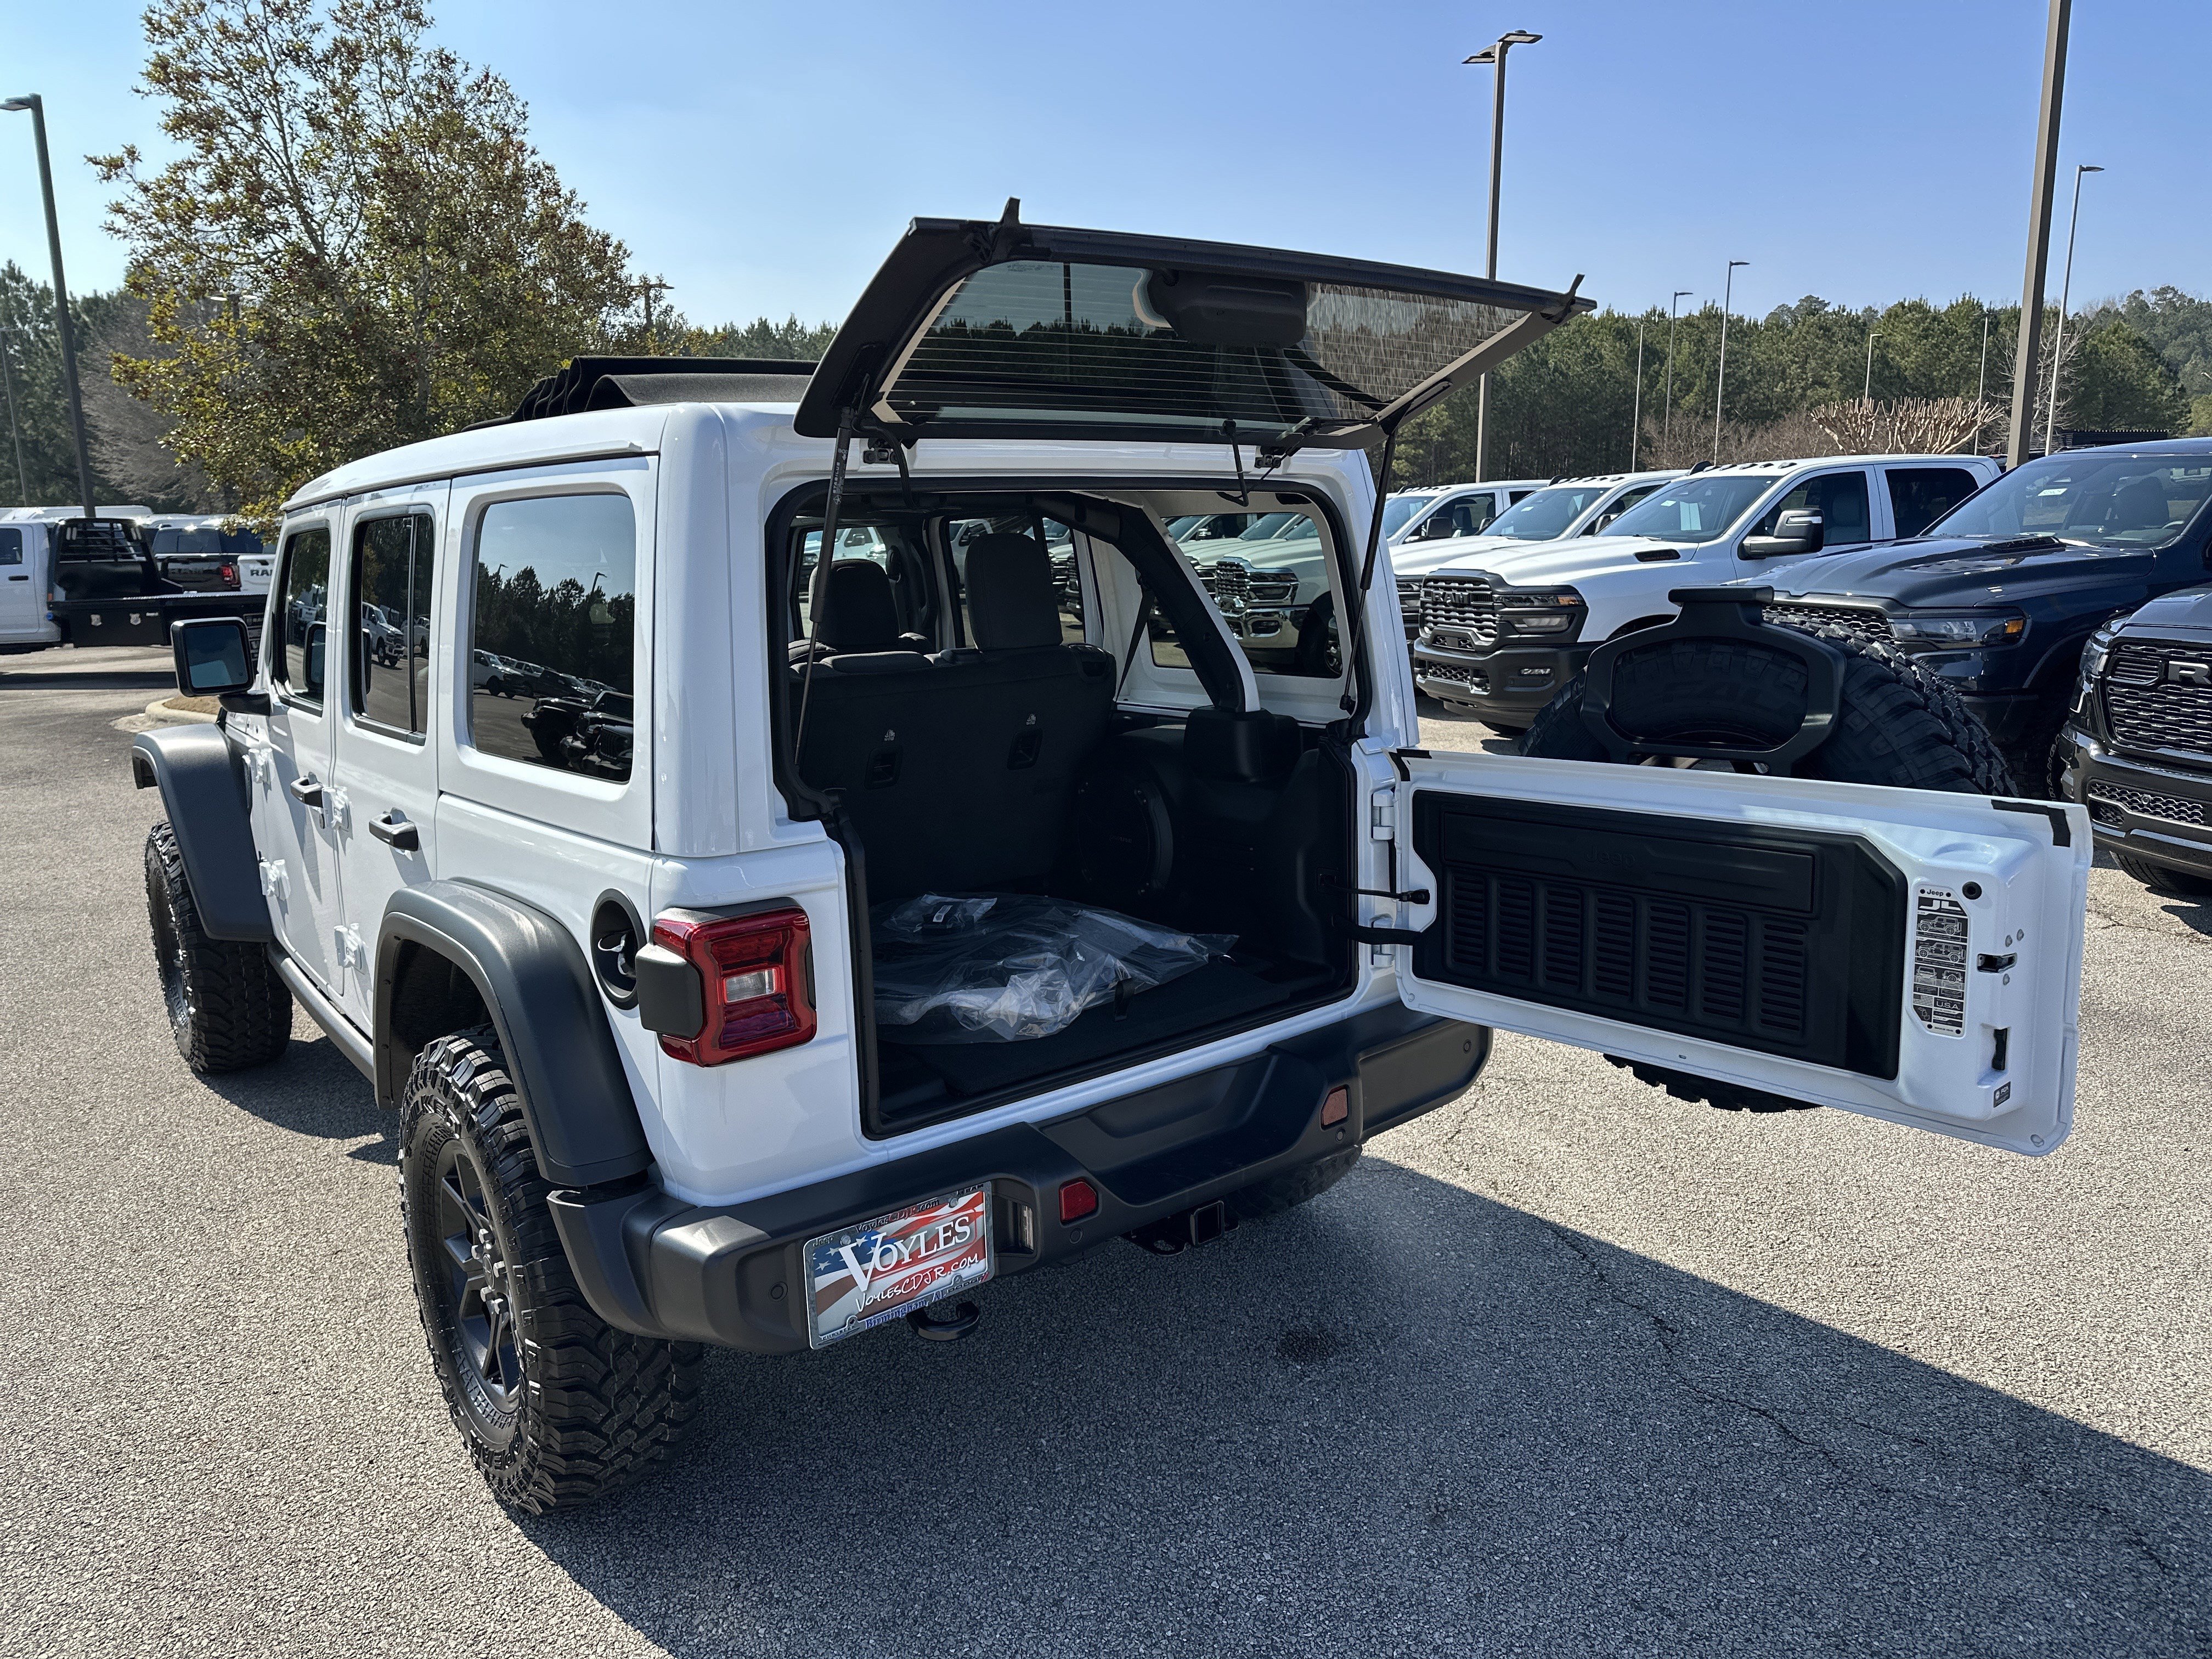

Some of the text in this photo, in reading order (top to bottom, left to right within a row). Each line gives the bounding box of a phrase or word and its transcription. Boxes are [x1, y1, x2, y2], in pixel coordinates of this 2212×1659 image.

[1432, 591, 1469, 604] RAM
[1583, 844, 1636, 870] Jeep
[1919, 899, 1961, 911] JL
[812, 1235, 834, 1248] Jeep
[932, 1290, 947, 1302] AL
